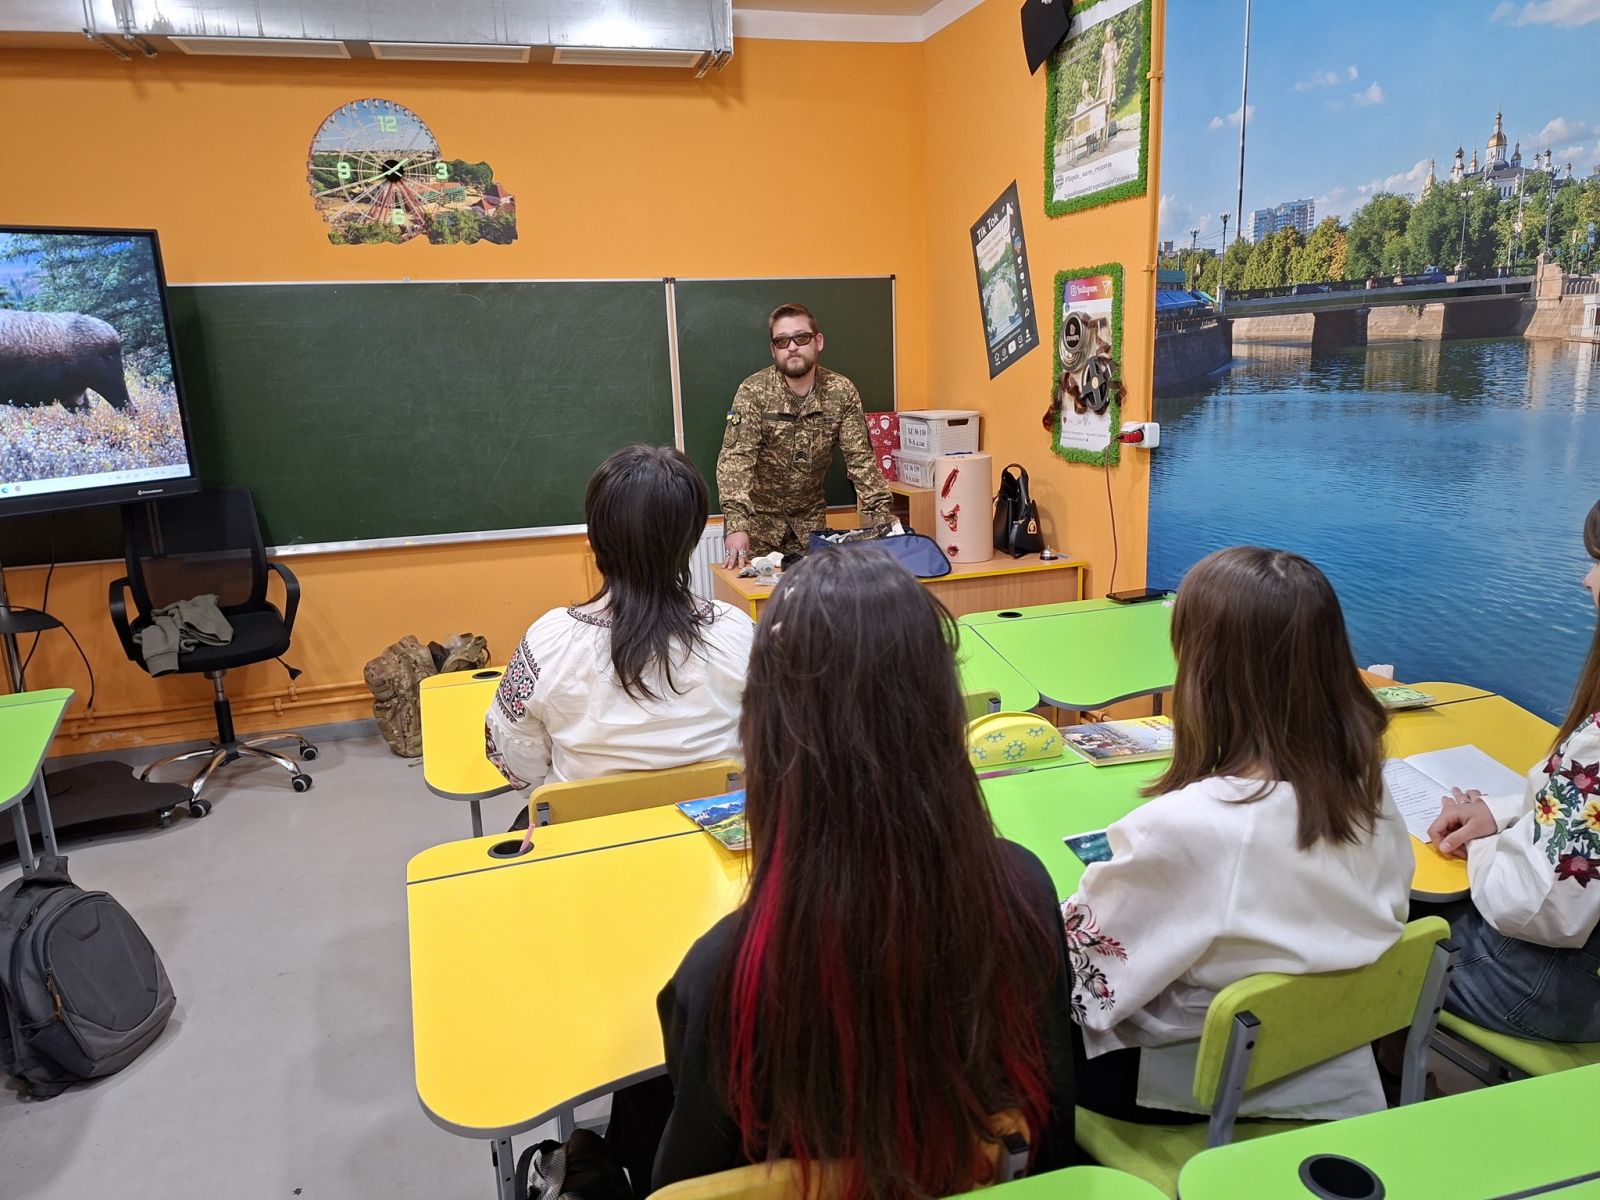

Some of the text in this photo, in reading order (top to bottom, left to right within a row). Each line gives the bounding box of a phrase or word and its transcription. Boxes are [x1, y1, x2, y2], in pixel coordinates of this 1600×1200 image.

[377, 115, 398, 133] 12
[337, 162, 350, 179] 9
[435, 163, 449, 180] 3
[391, 208, 406, 225] 6
[976, 224, 987, 241] Tik
[986, 212, 1000, 229] Tok
